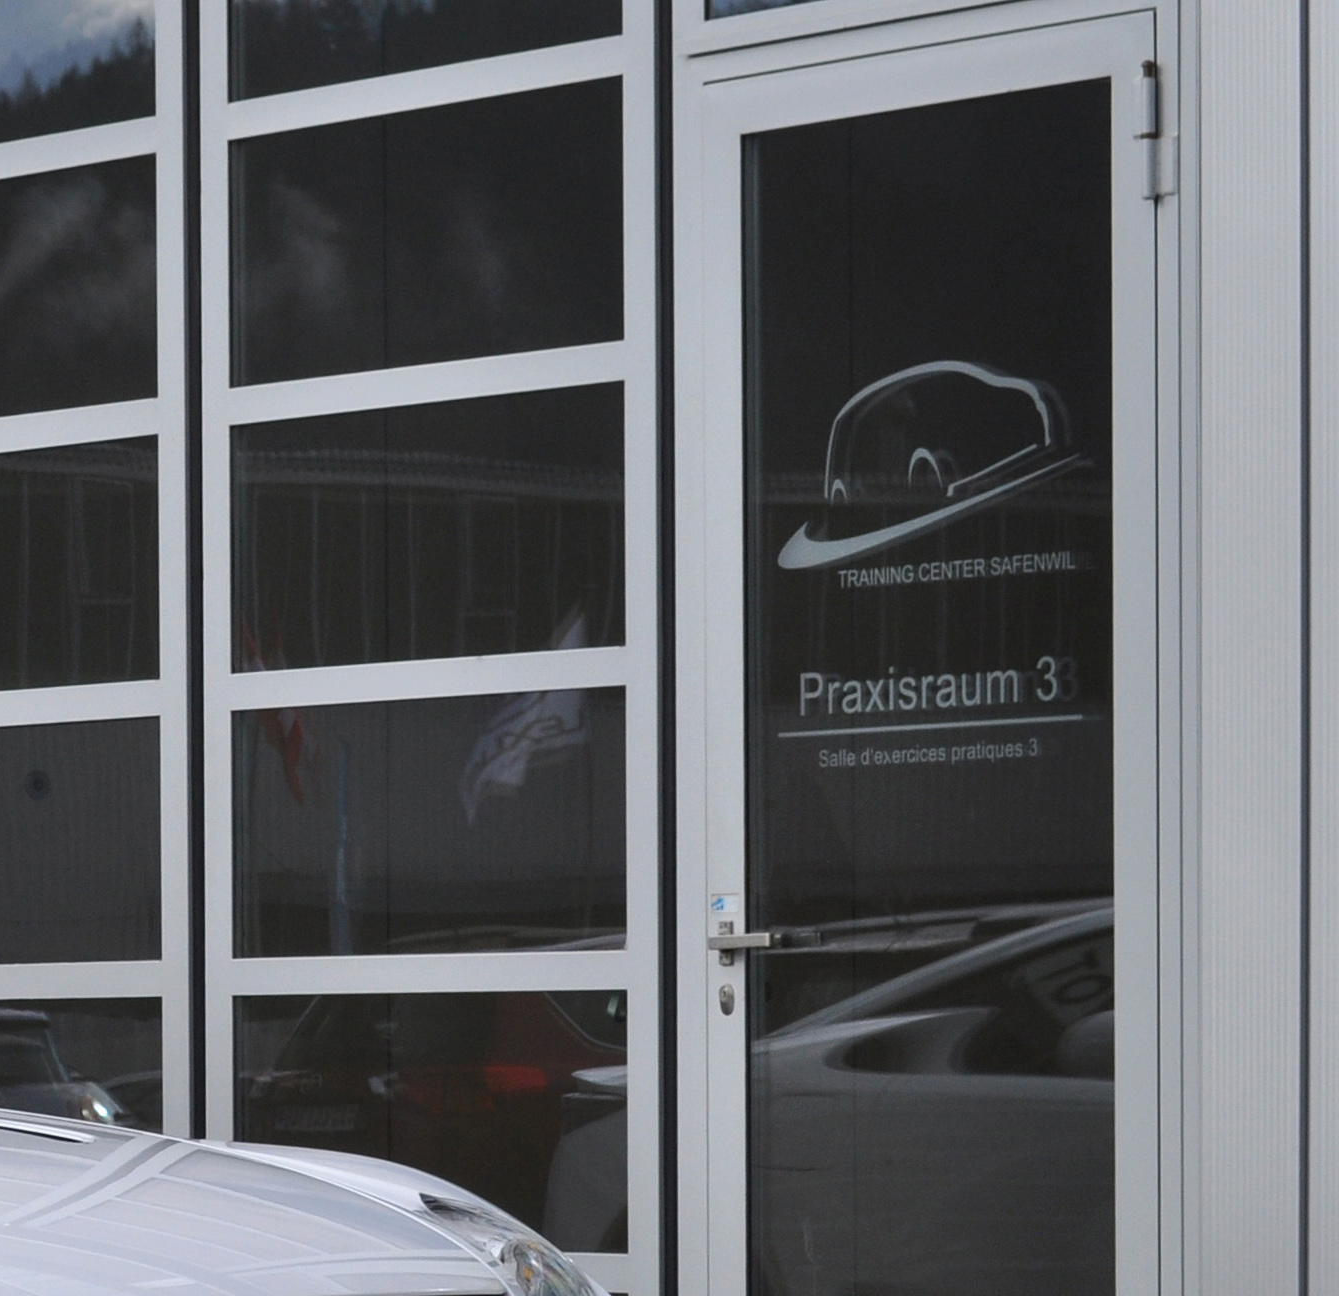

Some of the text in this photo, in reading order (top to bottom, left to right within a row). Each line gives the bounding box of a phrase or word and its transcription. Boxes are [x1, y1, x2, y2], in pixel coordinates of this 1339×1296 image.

[837, 550, 1076, 588] TRAINING CENTER SAFENWIL
[799, 655, 1058, 716] Praxisraum 3
[818, 738, 1039, 768] Salle d'exercices pratiques 3
